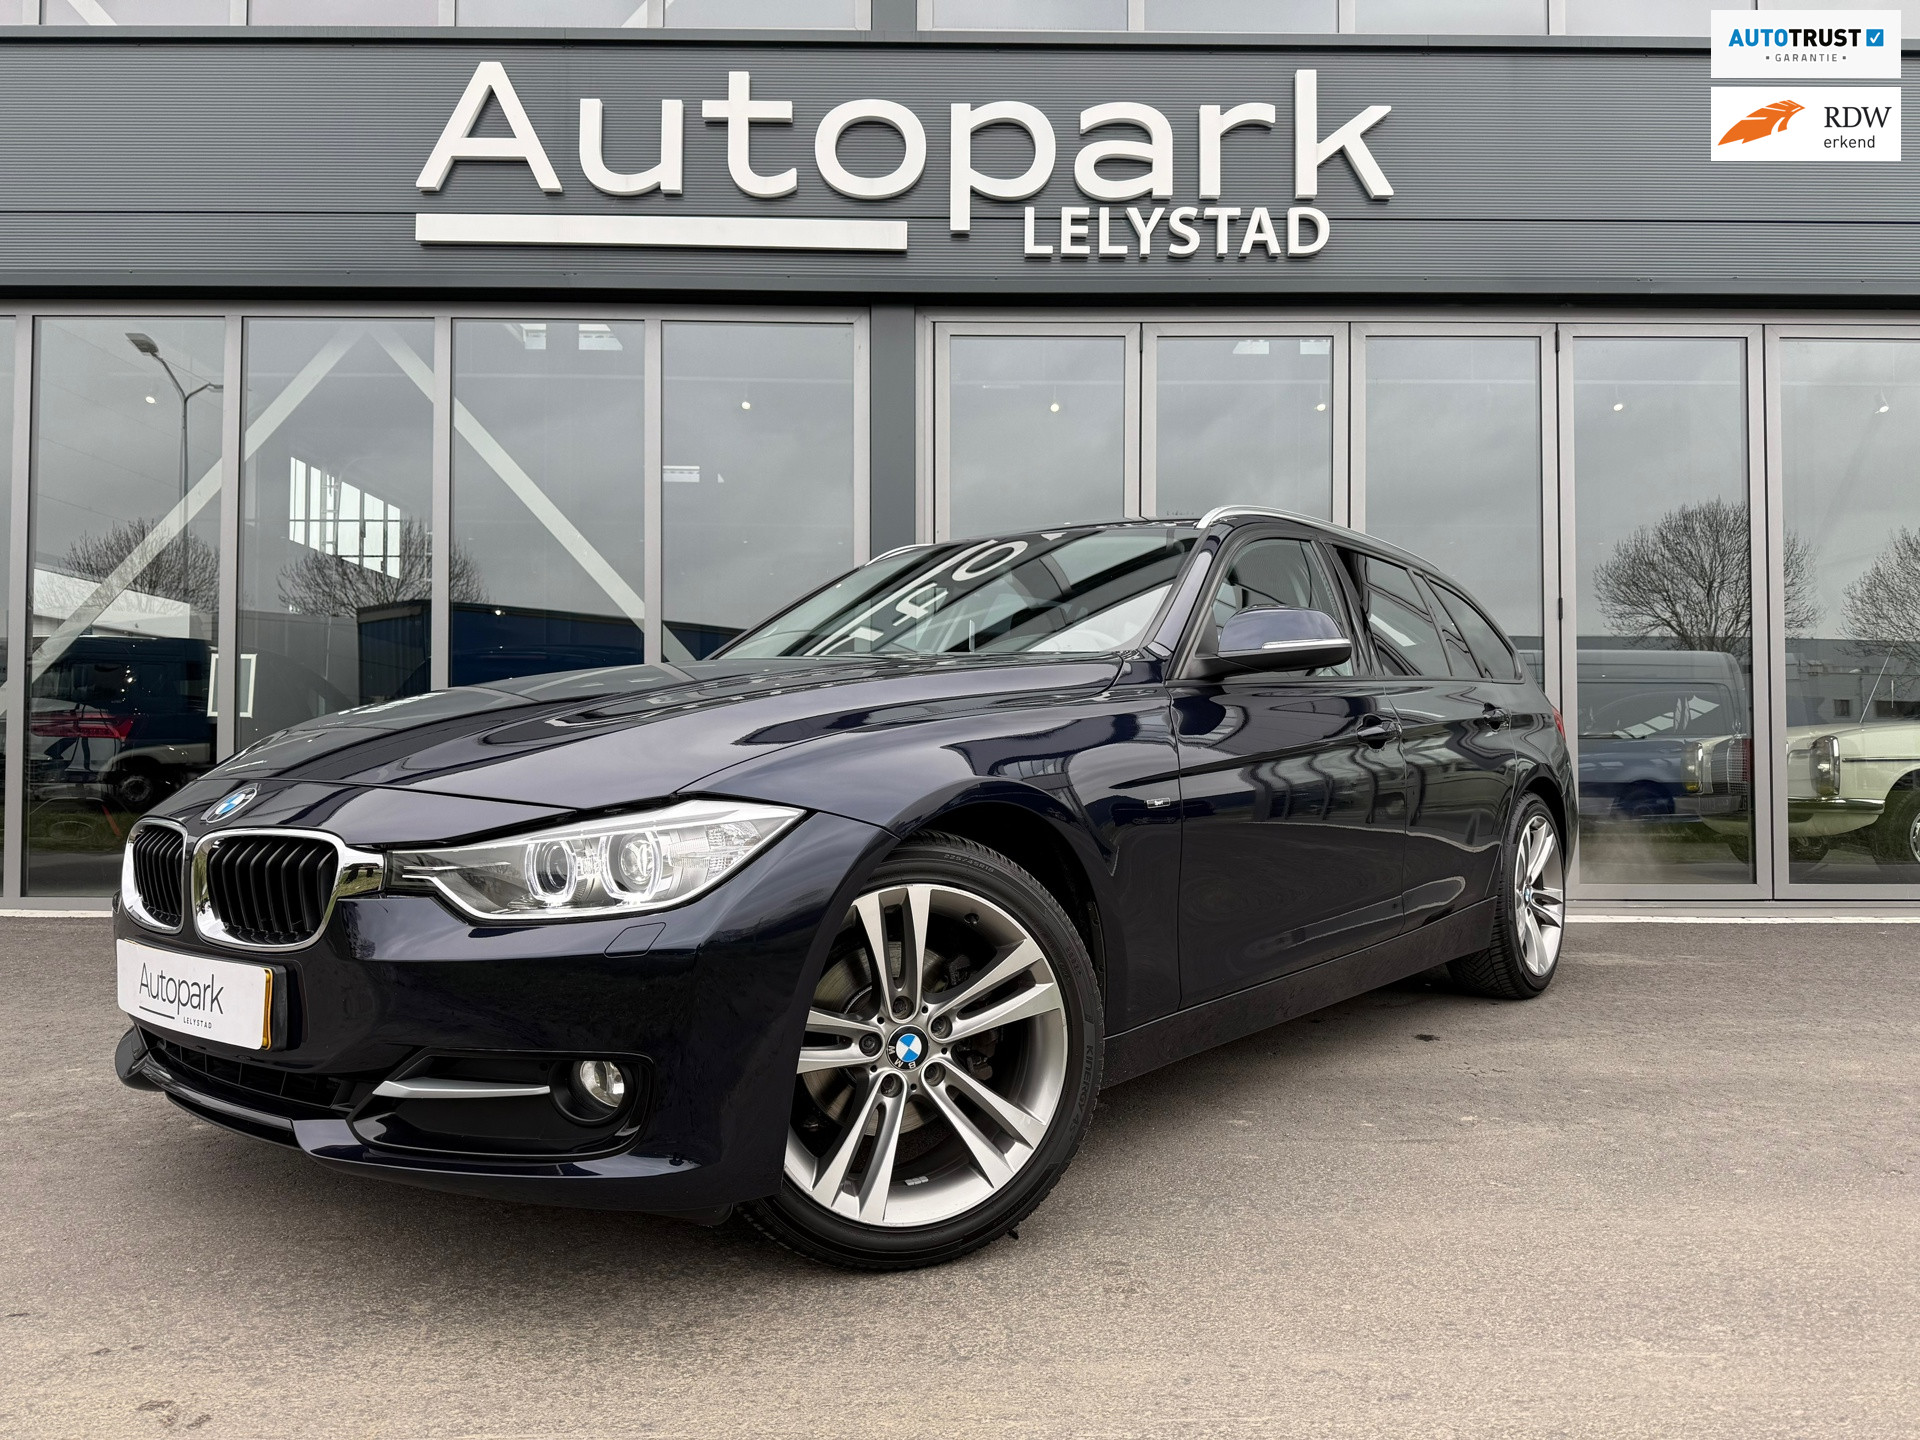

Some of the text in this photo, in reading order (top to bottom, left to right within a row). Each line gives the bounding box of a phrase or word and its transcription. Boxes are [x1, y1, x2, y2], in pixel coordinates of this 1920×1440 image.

[415, 61, 1395, 235] Autopark
[1024, 206, 1331, 258] LELYSTAD
[139, 962, 224, 1015] Autopark
[183, 1016, 213, 1029] LELYSTAD
[888, 1045, 917, 1069] BMW
